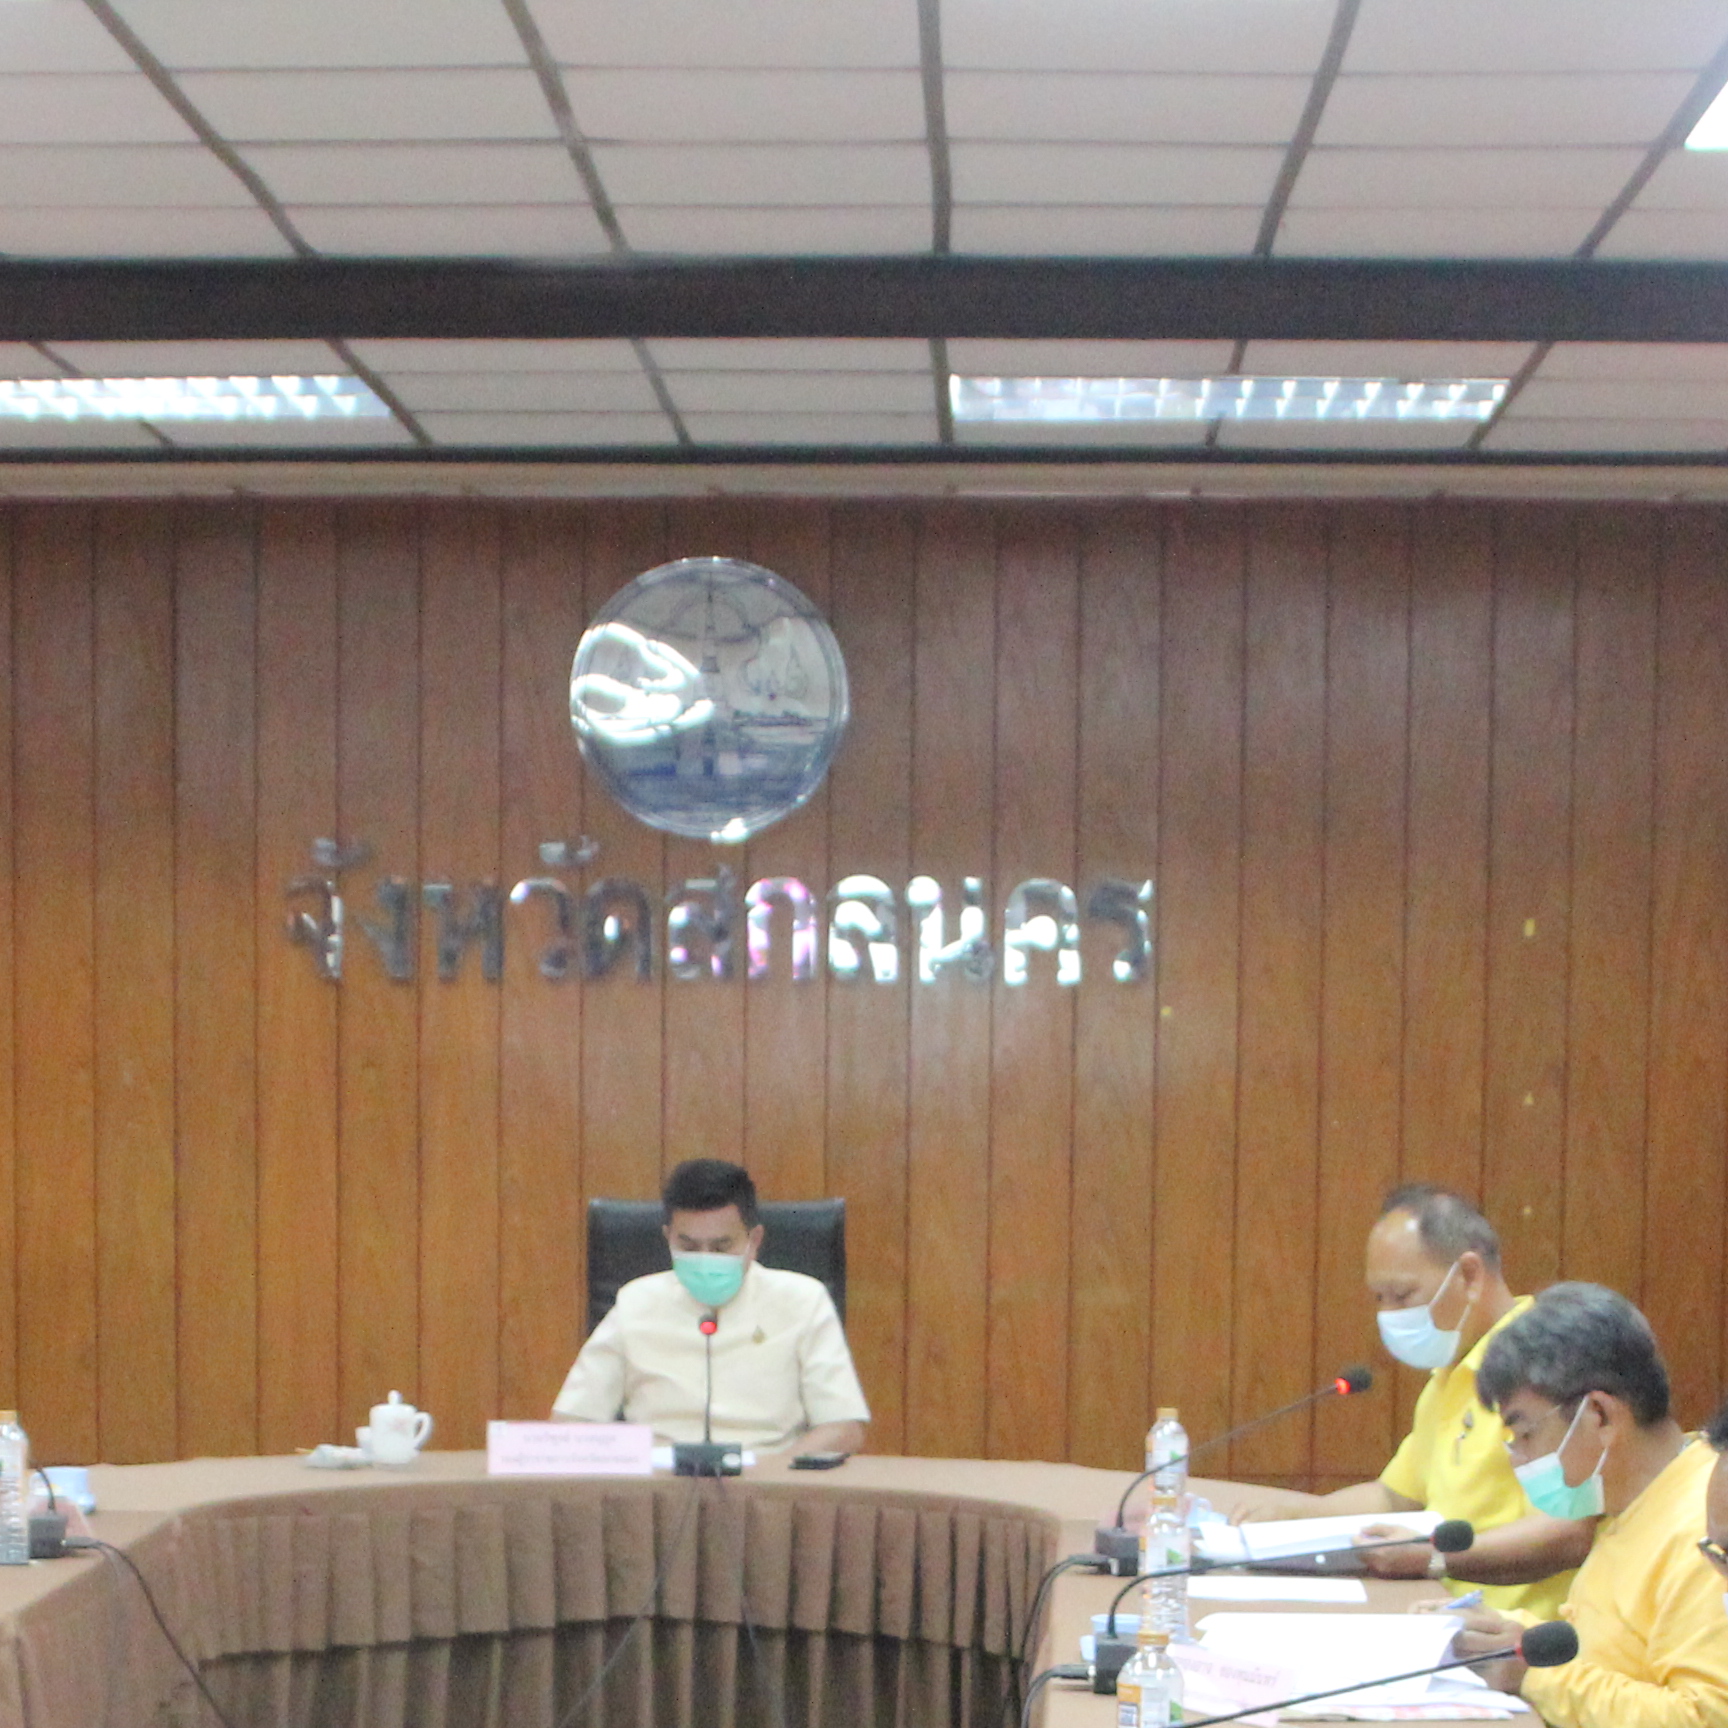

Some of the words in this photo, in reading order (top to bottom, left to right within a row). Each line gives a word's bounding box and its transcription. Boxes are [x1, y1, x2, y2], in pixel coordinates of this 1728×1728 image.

[284, 836, 1154, 985] จังหวัดสกลนคร
